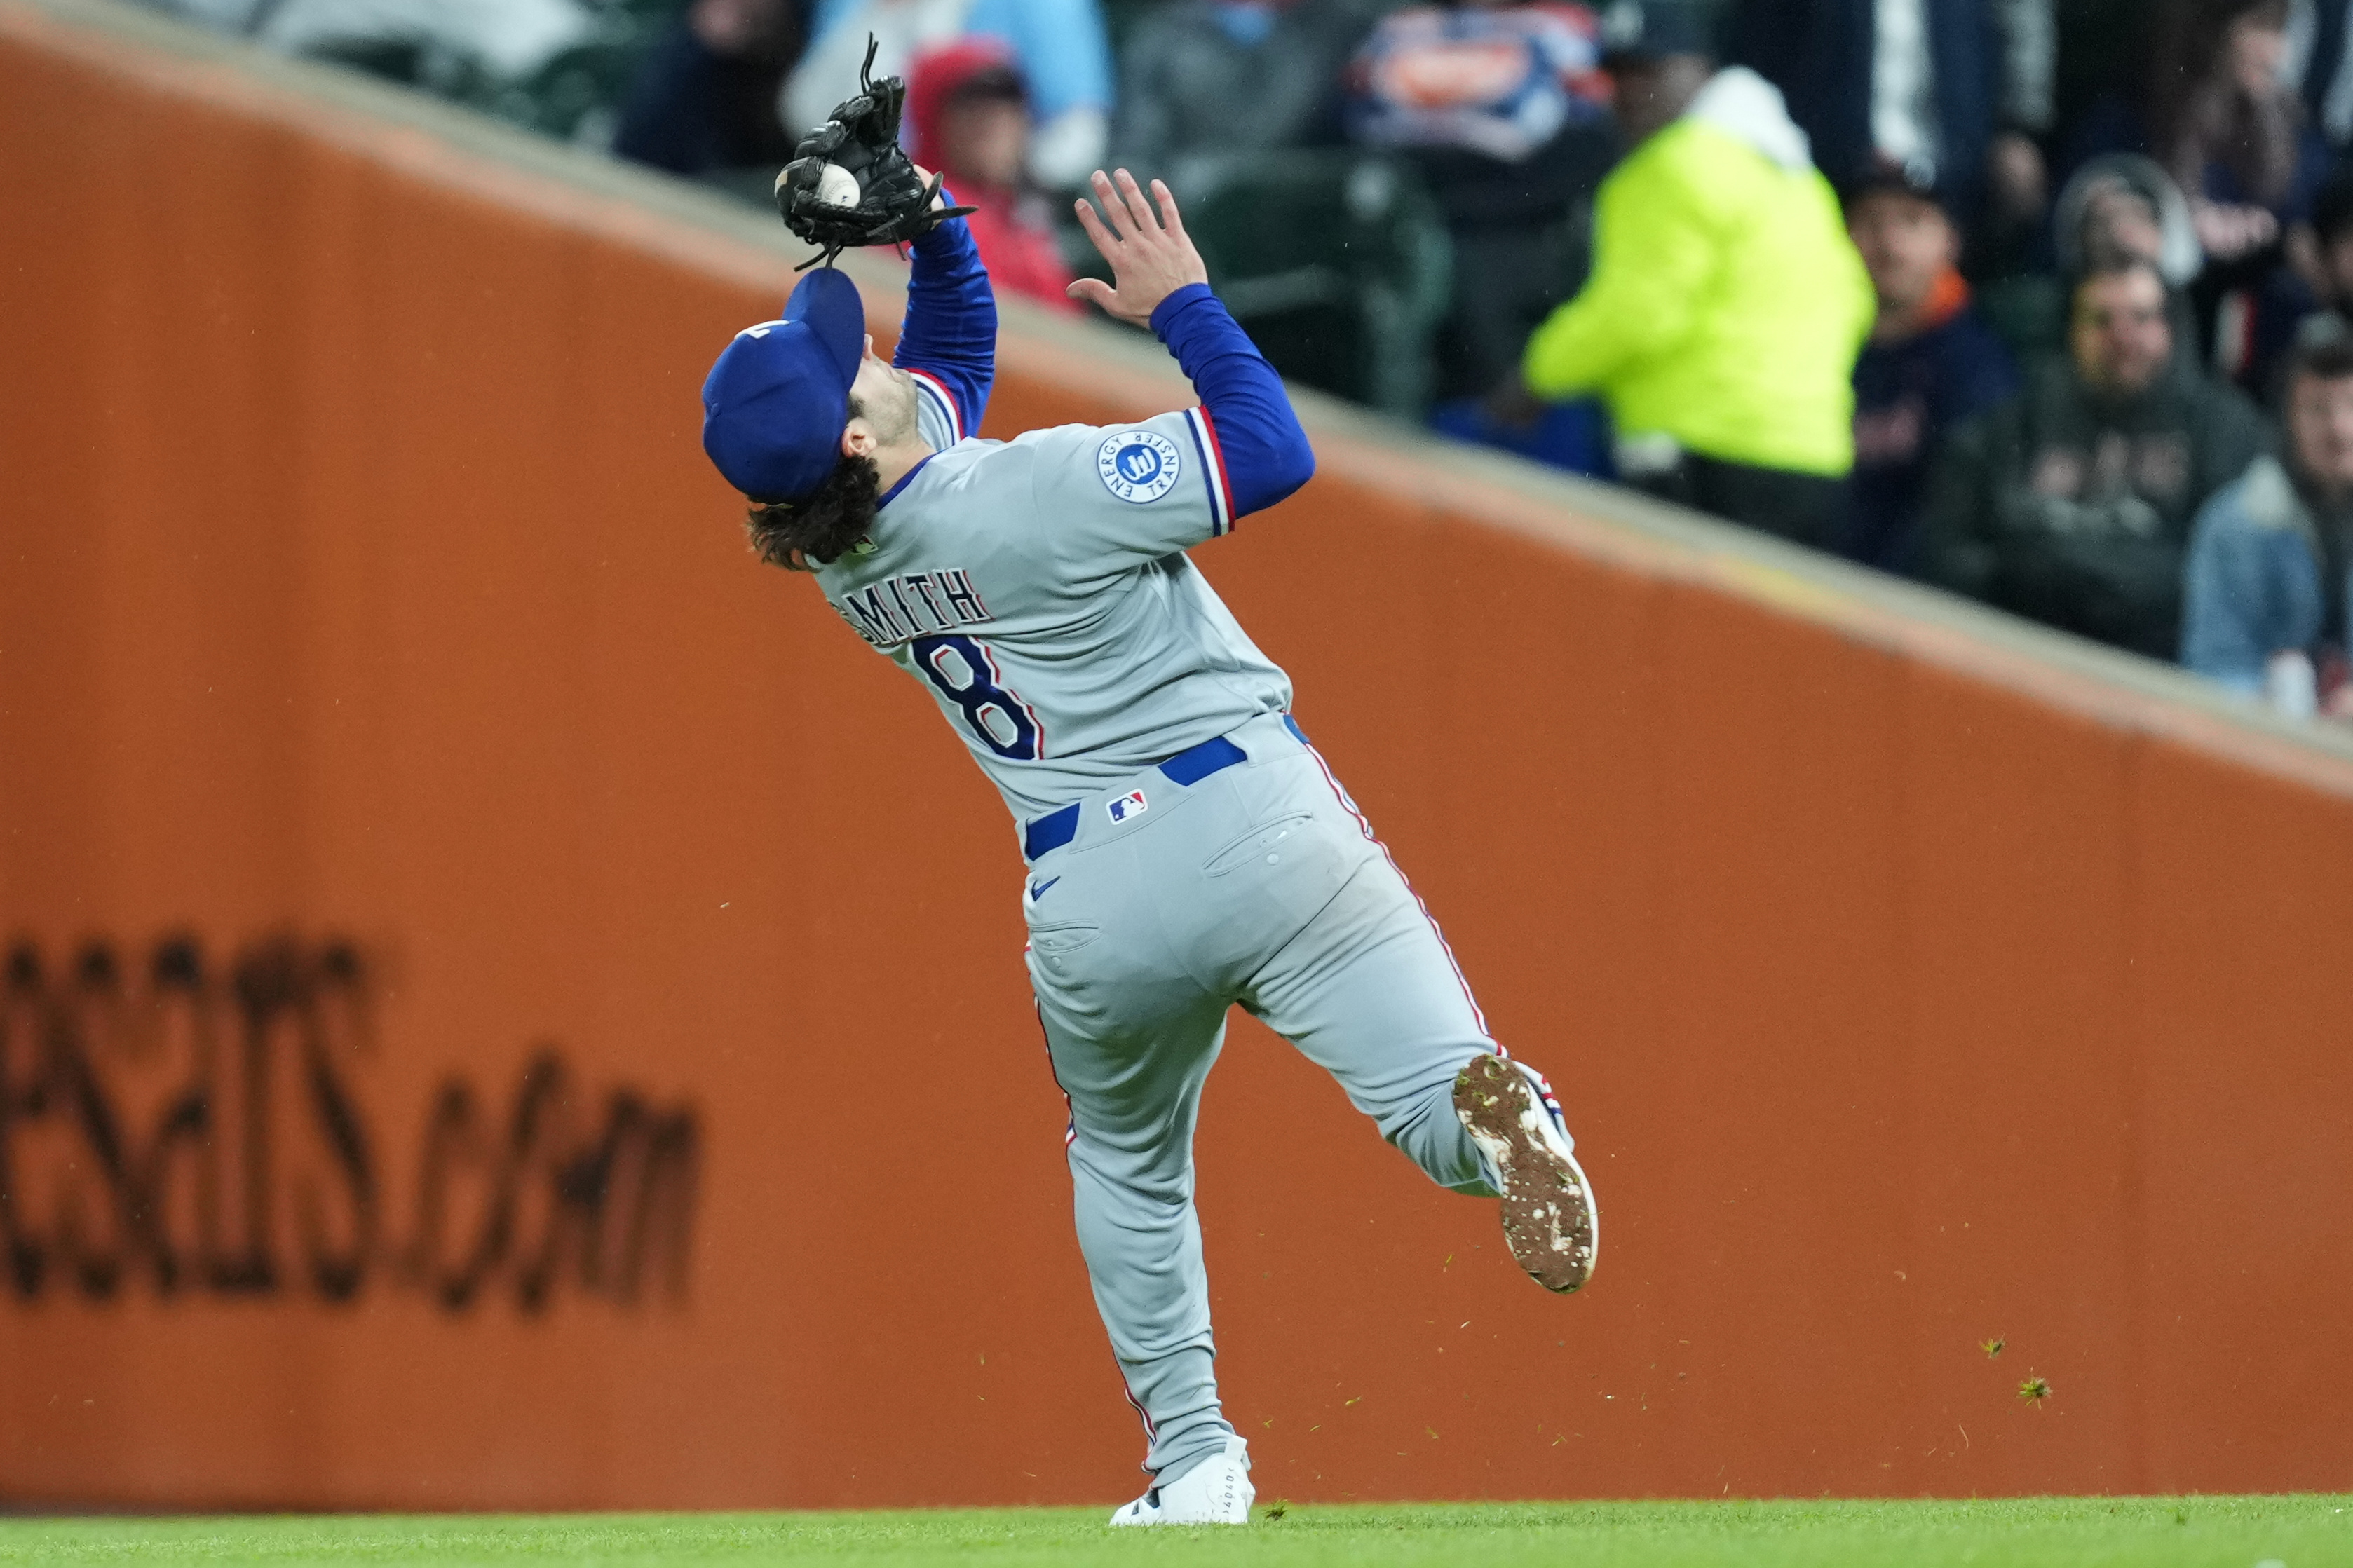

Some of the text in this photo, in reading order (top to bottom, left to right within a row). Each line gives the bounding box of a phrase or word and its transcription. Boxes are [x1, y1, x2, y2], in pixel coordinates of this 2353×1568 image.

[1101, 432, 1177, 498] ENERGY TRANSFER
[907, 634, 1044, 761] 8
